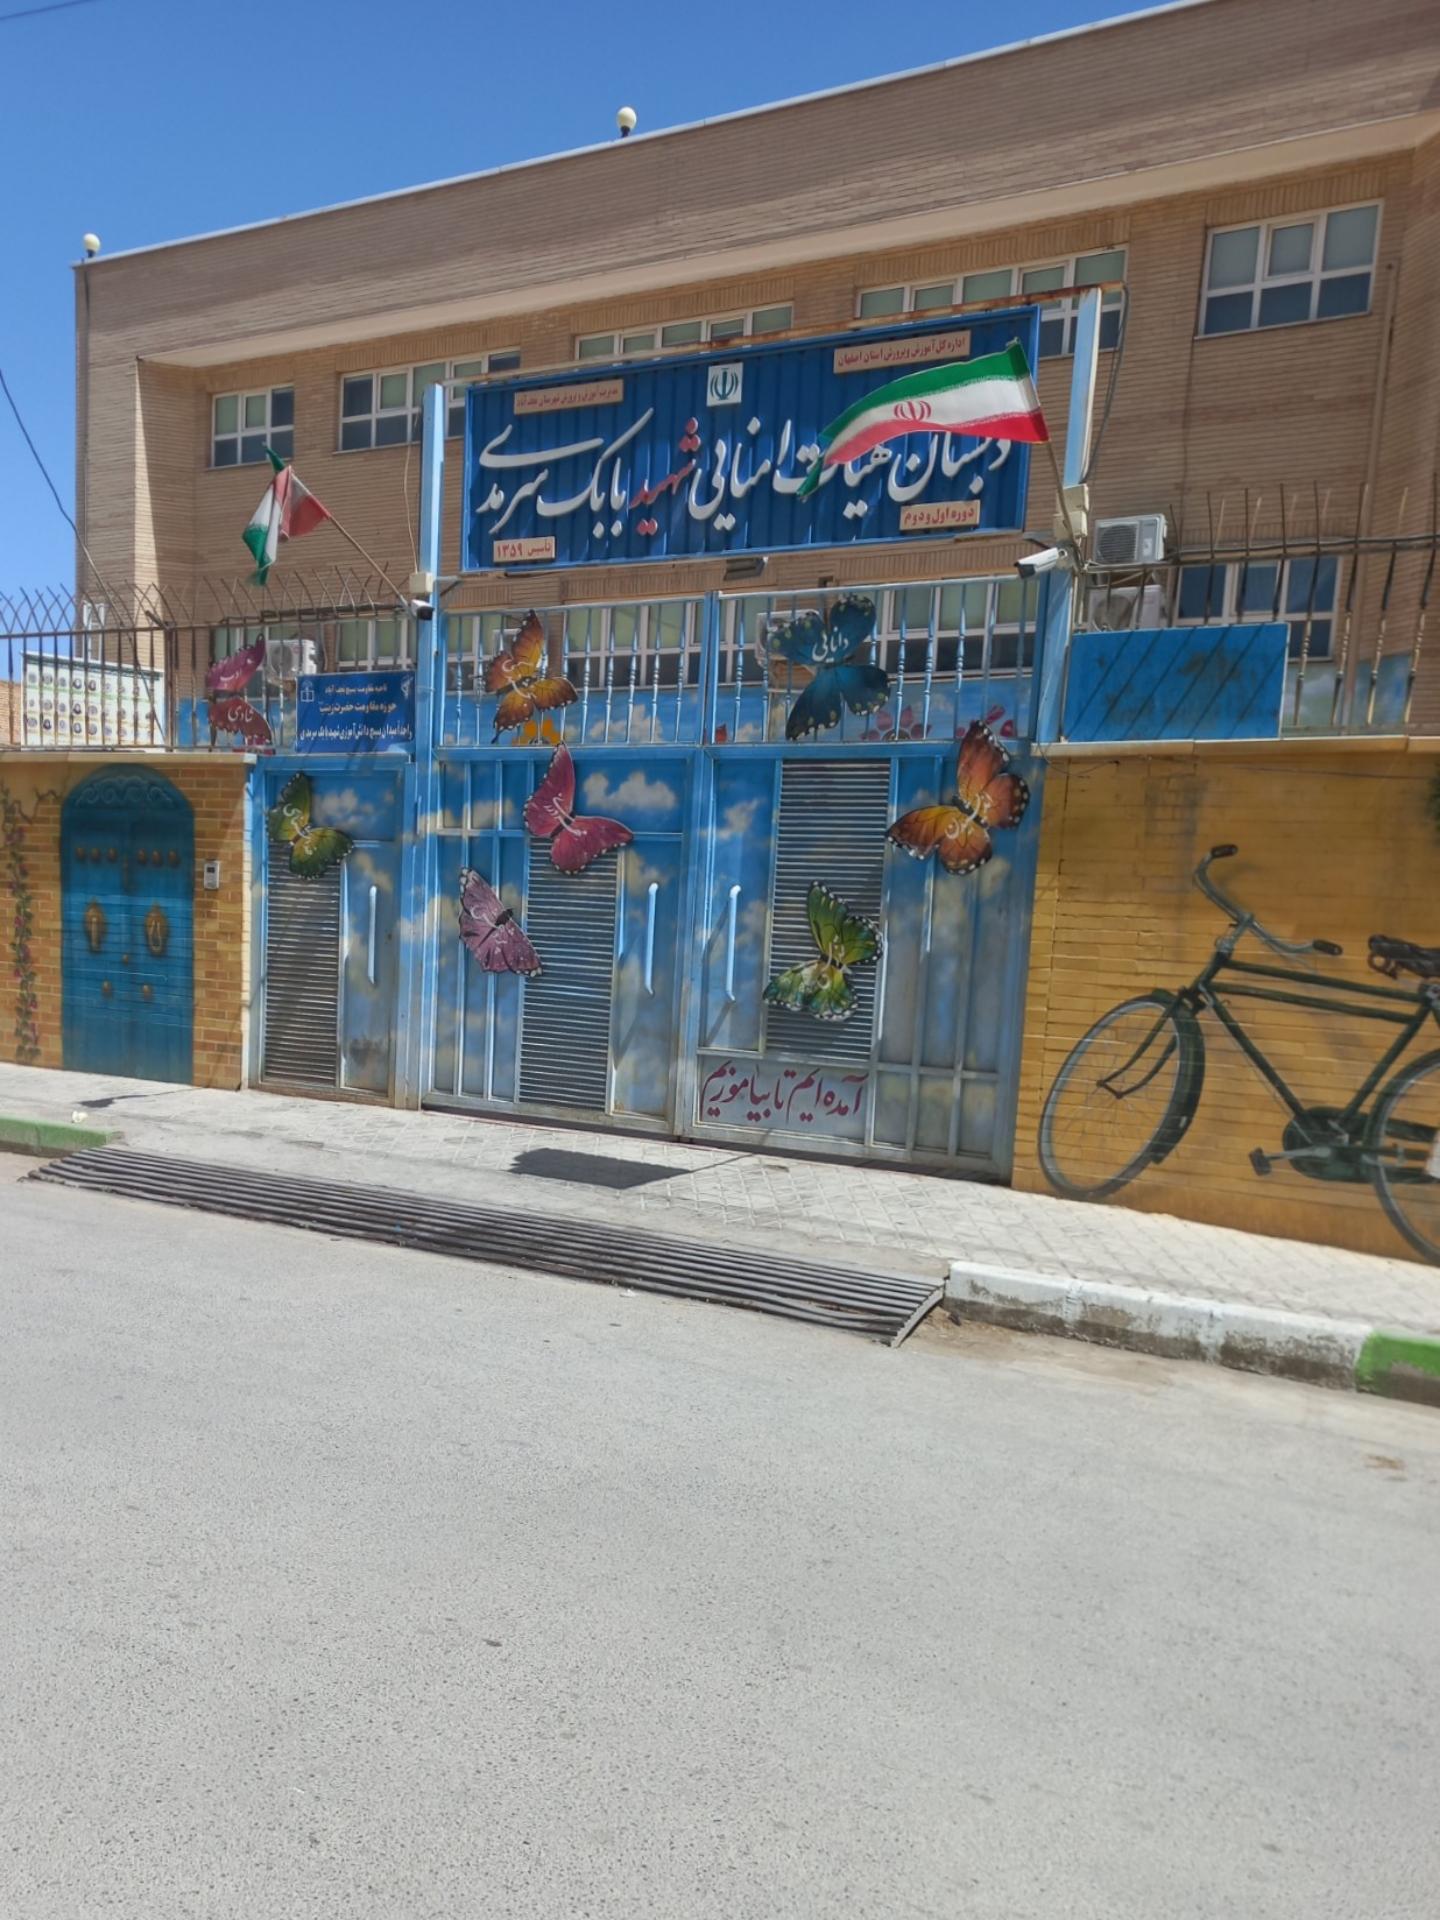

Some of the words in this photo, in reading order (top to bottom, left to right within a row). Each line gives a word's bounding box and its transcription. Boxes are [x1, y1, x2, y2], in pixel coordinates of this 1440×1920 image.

[537, 407, 654, 539] بابک
[629, 416, 702, 536] شهید
[931, 507, 950, 524] اول
[951, 507, 975, 523] دوره
[497, 542, 523, 559] ۱۳۵۹
[700, 1060, 772, 1122] بیاموزیم
[774, 1069, 797, 1110] تا
[786, 1068, 823, 1124] ایم
[823, 1072, 869, 1115] آمده
